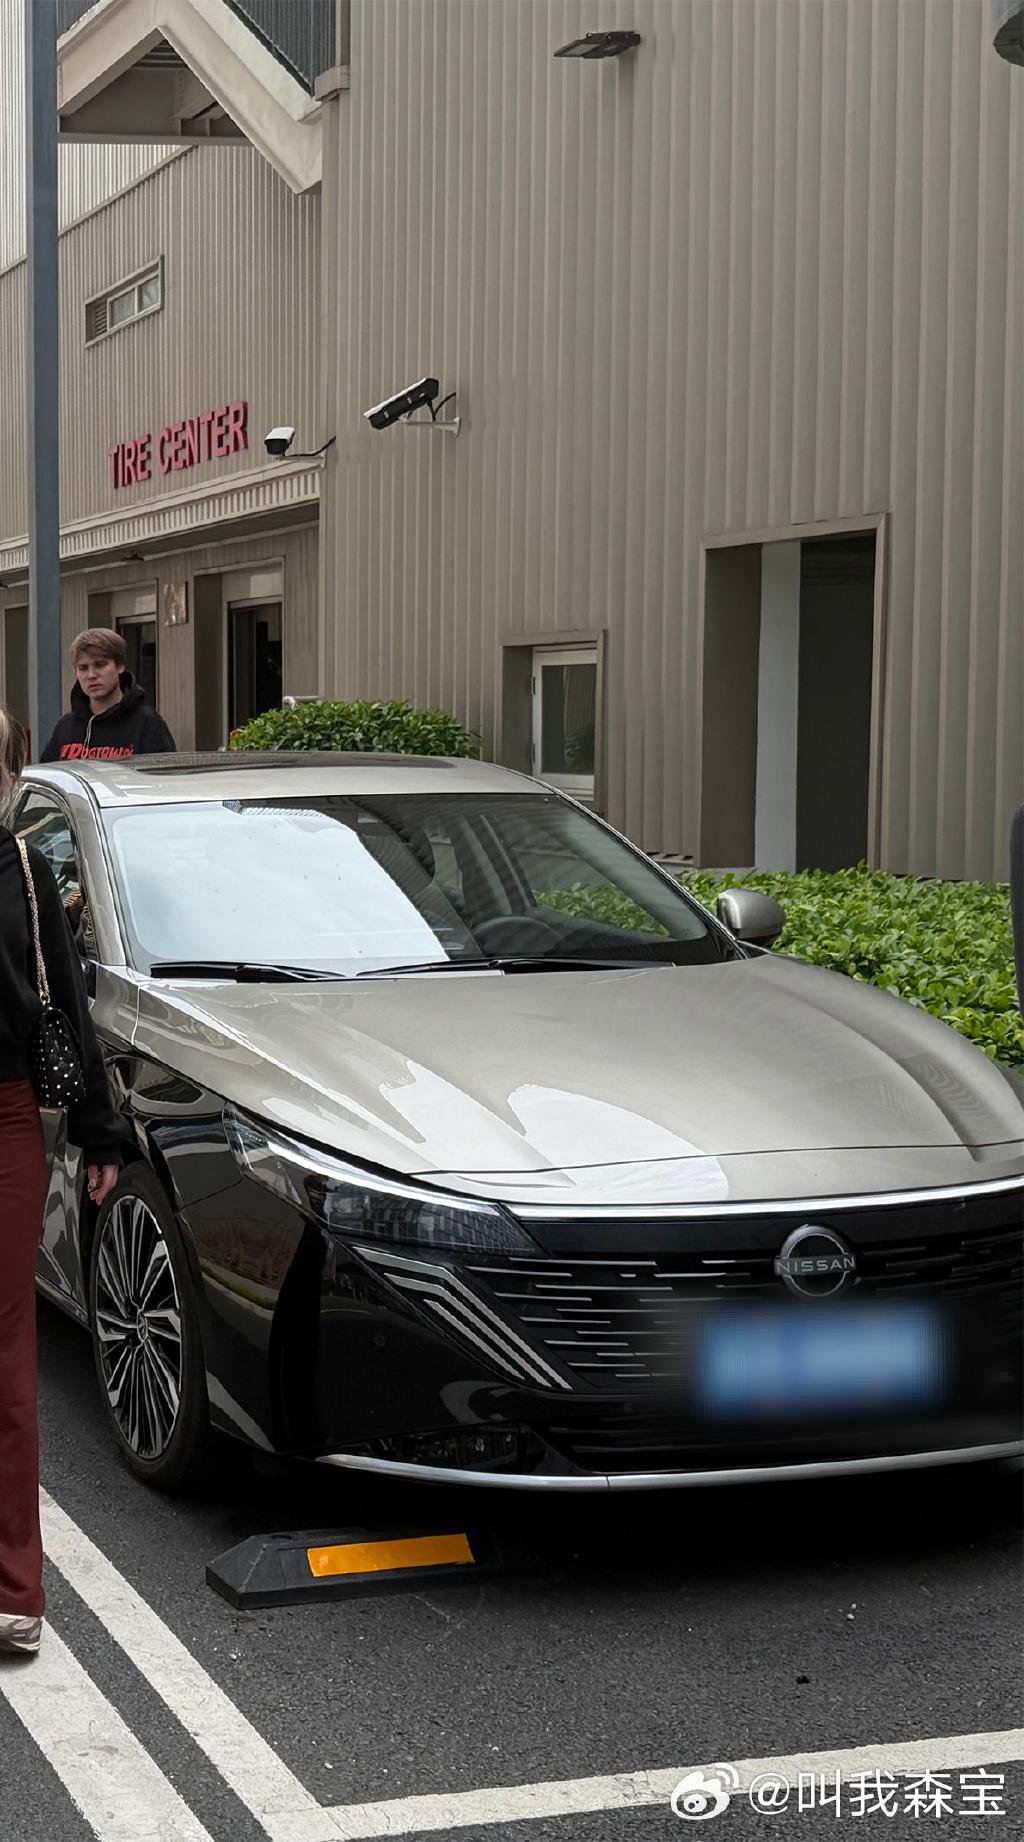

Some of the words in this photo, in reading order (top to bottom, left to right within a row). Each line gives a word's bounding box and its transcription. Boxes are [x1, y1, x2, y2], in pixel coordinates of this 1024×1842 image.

[110, 433, 152, 489] TIRE
[158, 400, 249, 475] CENTER
[776, 1256, 855, 1273] NISSAN
